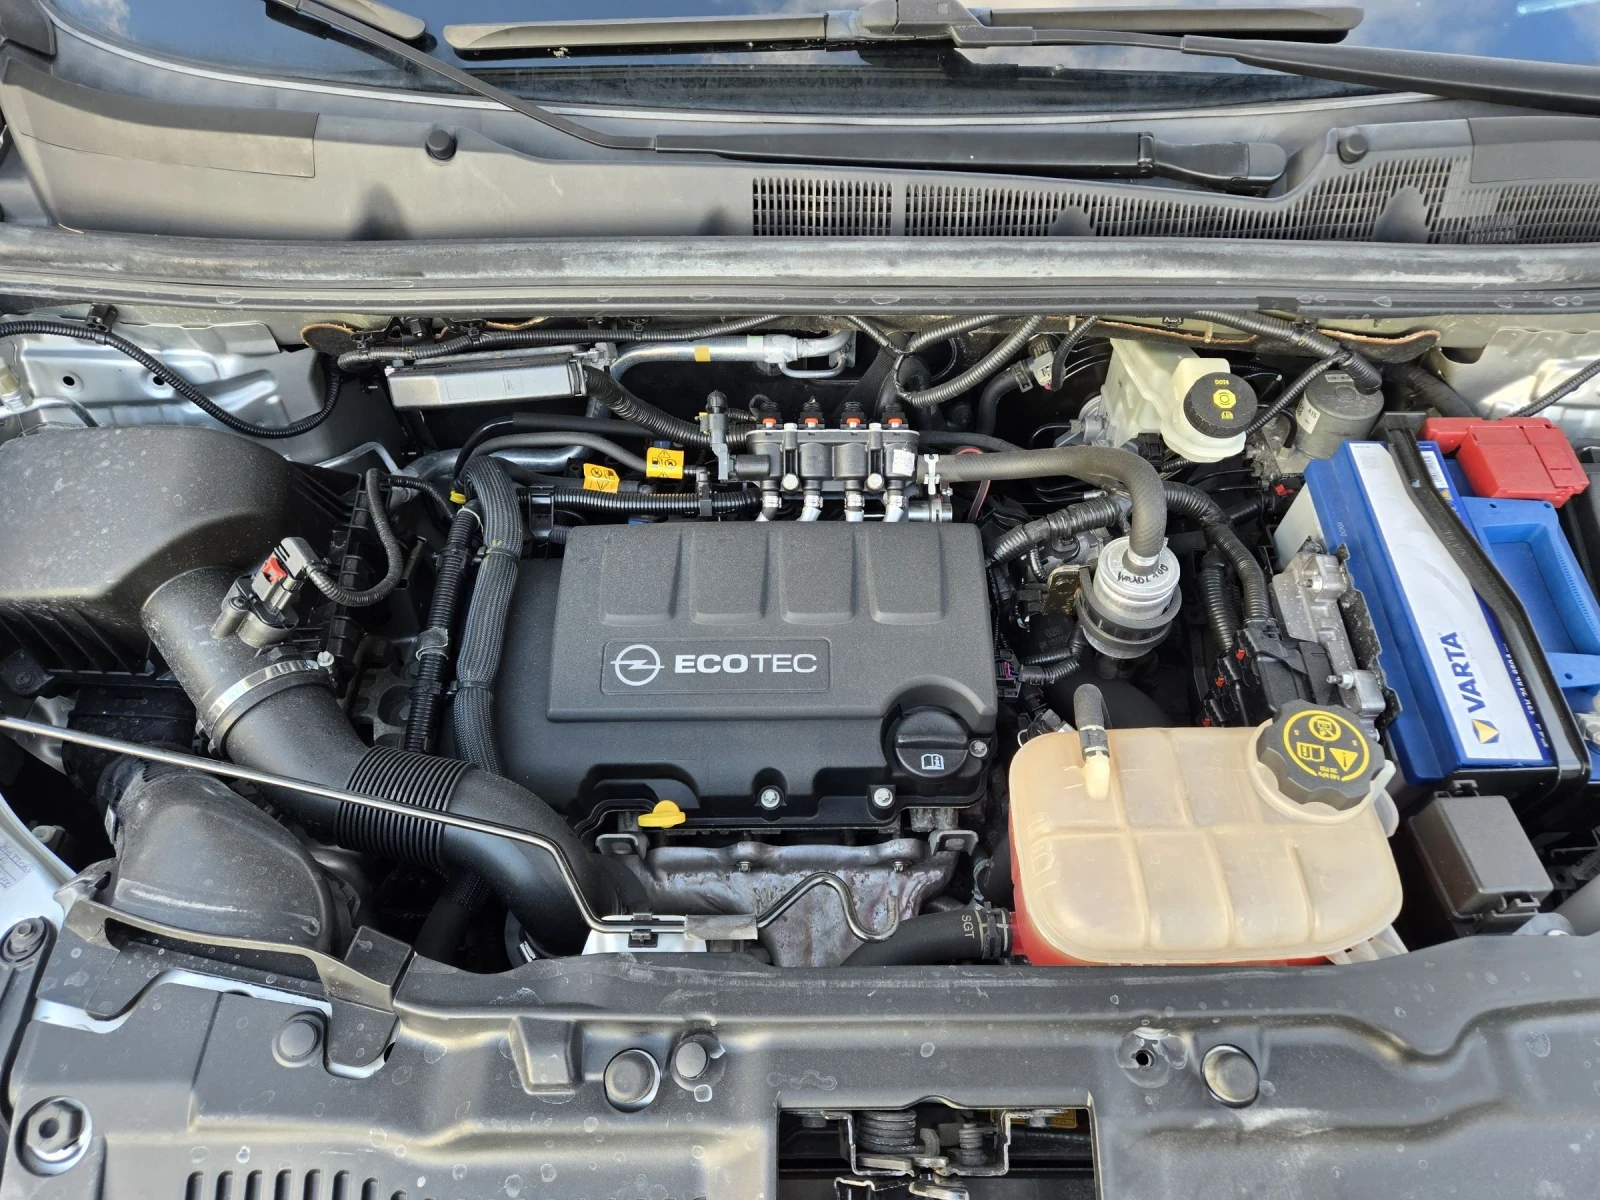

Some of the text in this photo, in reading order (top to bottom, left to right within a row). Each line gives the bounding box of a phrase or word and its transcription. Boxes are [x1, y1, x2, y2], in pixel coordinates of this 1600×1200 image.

[674, 653, 817, 674] ECOTEC
[1439, 631, 1487, 714] VARTA
[961, 915, 975, 939] SGT
